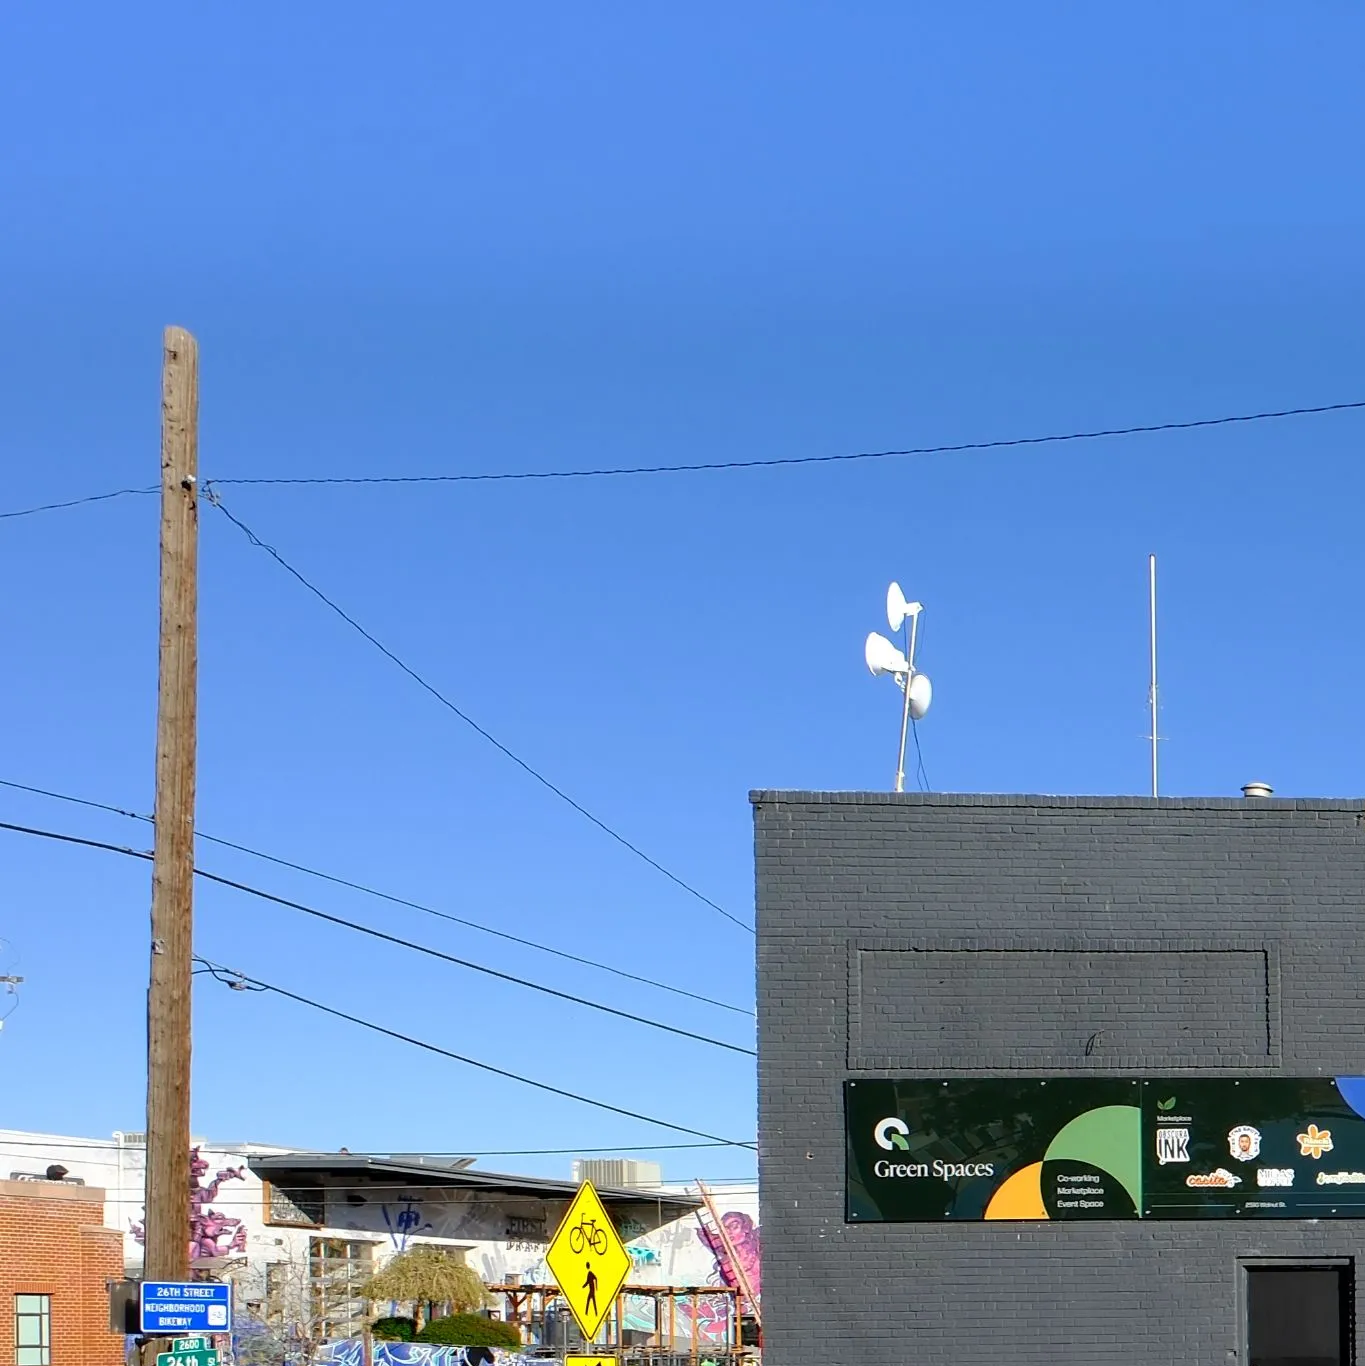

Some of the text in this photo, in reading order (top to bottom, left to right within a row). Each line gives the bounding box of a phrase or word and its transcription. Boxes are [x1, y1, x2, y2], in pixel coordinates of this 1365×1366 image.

[1159, 1130, 1187, 1139] OBSCURA
[1159, 1138, 1188, 1159] INK
[874, 1160, 994, 1182] Green Spaces
[1057, 1174, 1100, 1185] Co-working
[1057, 1187, 1104, 1197] Marketplace
[1057, 1200, 1104, 1210] Event Space
[157, 1287, 216, 1298] 26TH STREET
[145, 1303, 206, 1313] NEIGHBORHOOD
[158, 1316, 192, 1327] BIKEWAY
[179, 1340, 200, 1351] 2600
